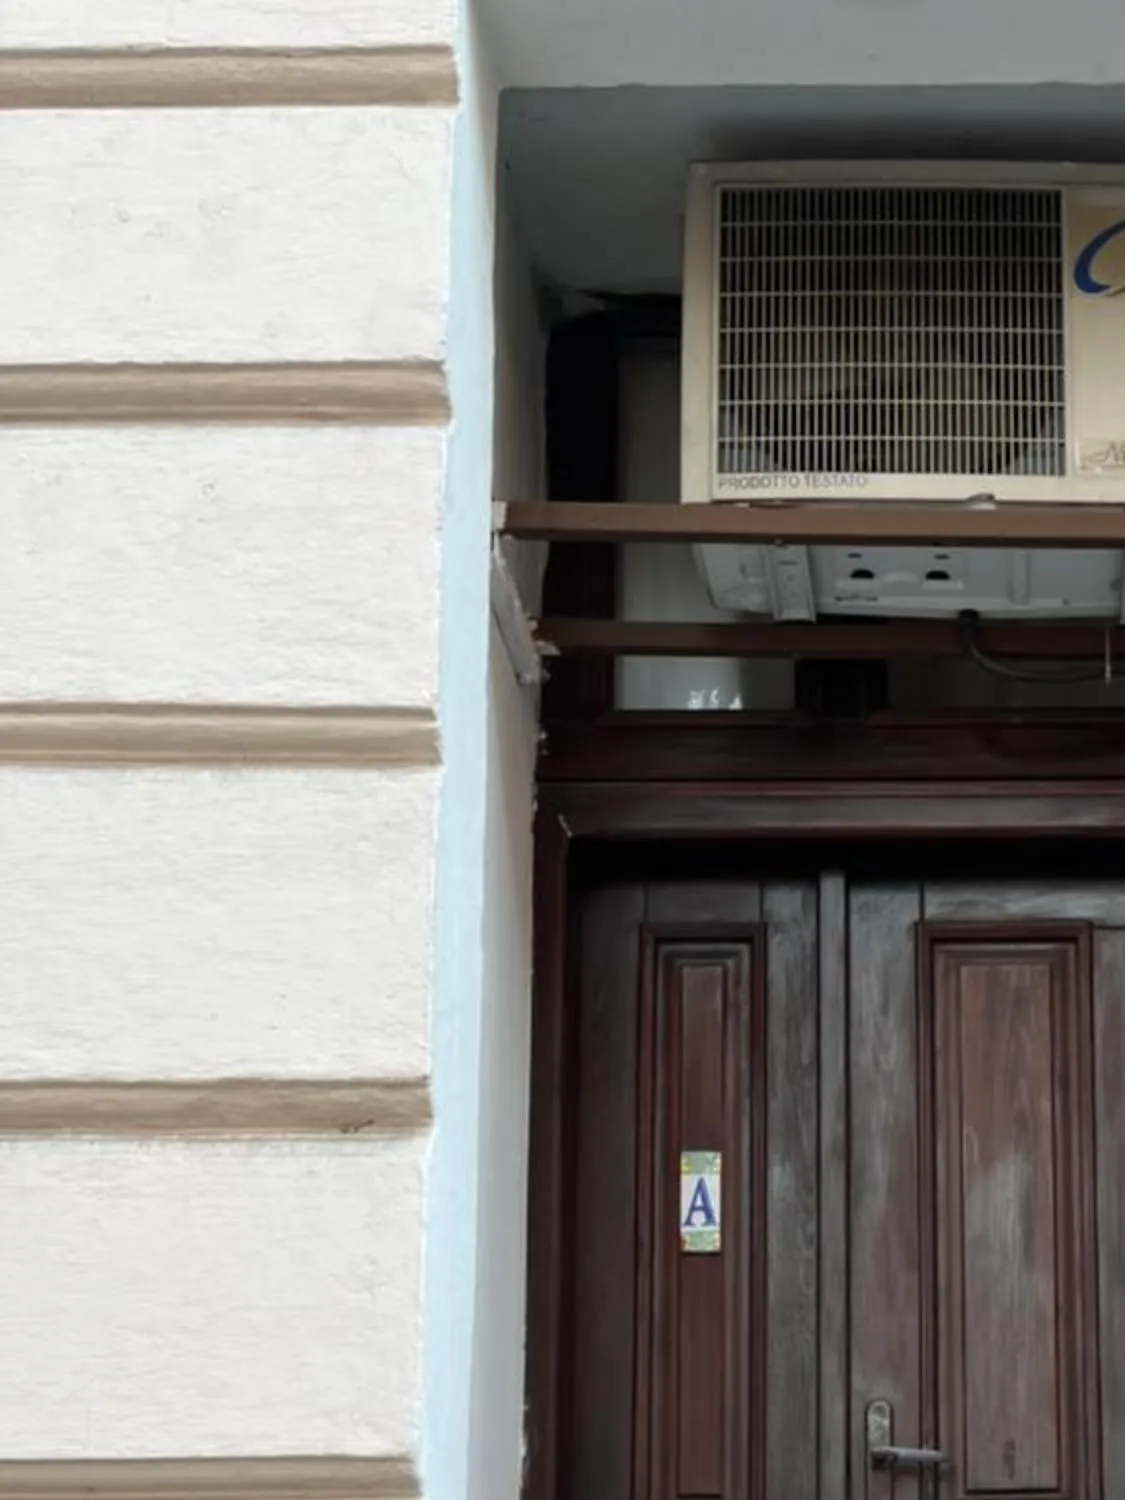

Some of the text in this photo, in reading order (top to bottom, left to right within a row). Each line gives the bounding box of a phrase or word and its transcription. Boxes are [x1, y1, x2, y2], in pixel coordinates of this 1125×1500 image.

[718, 473, 868, 490] PRODOTTO TESTATO
[683, 1176, 717, 1226] A
